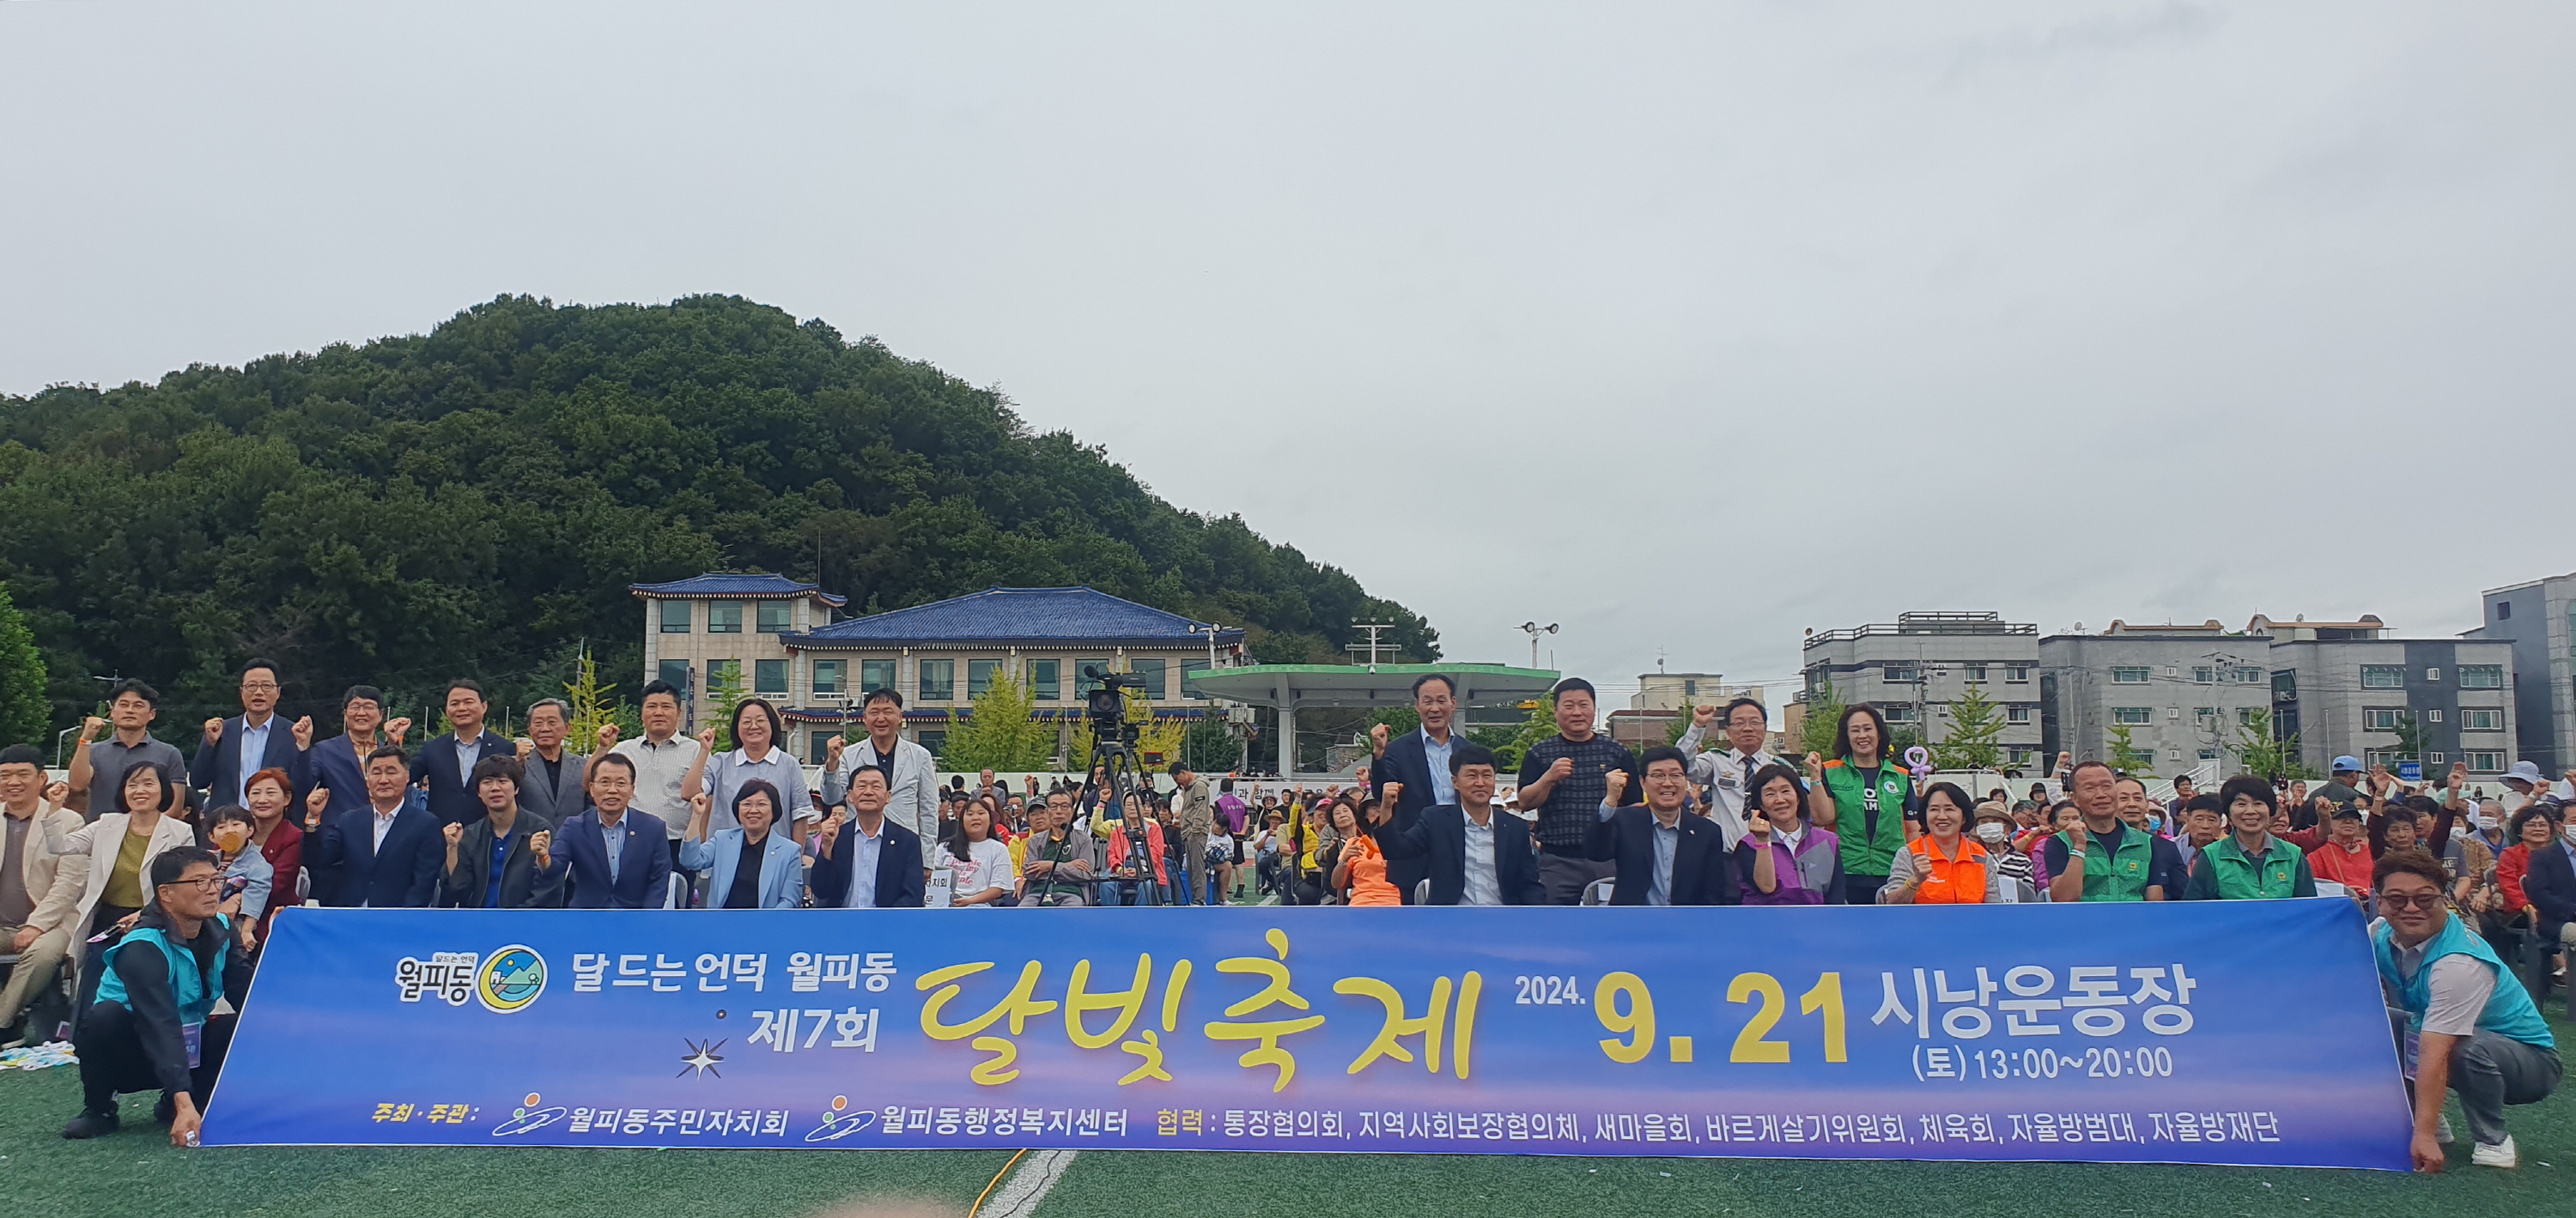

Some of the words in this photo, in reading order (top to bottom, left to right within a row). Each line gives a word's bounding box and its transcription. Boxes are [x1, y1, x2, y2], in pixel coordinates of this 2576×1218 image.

[398, 960, 473, 1003] 월피동
[695, 954, 768, 992] 언덕
[787, 952, 897, 992] 월피동
[1515, 975, 1587, 1006] 2024.
[915, 928, 1483, 1094] 달빛축제
[1870, 963, 2197, 1039] 시낭운동장
[747, 1006, 879, 1053] 제7회
[568, 1106, 789, 1138] 월피동주민자치회
[879, 1104, 1128, 1137] 월피동행정복지센터
[1223, 1108, 1352, 1141] 통장협의회,
[1358, 1110, 1588, 1144] 지역사회보장협의체,
[1595, 1113, 1701, 1145] 새마을회,
[1705, 1113, 1916, 1146] 바르게살기위원회,
[1918, 1113, 2004, 1146] 체육회,
[2007, 1112, 2146, 1145] 자율방범대,
[2148, 1111, 2281, 1143] 자율방재단
